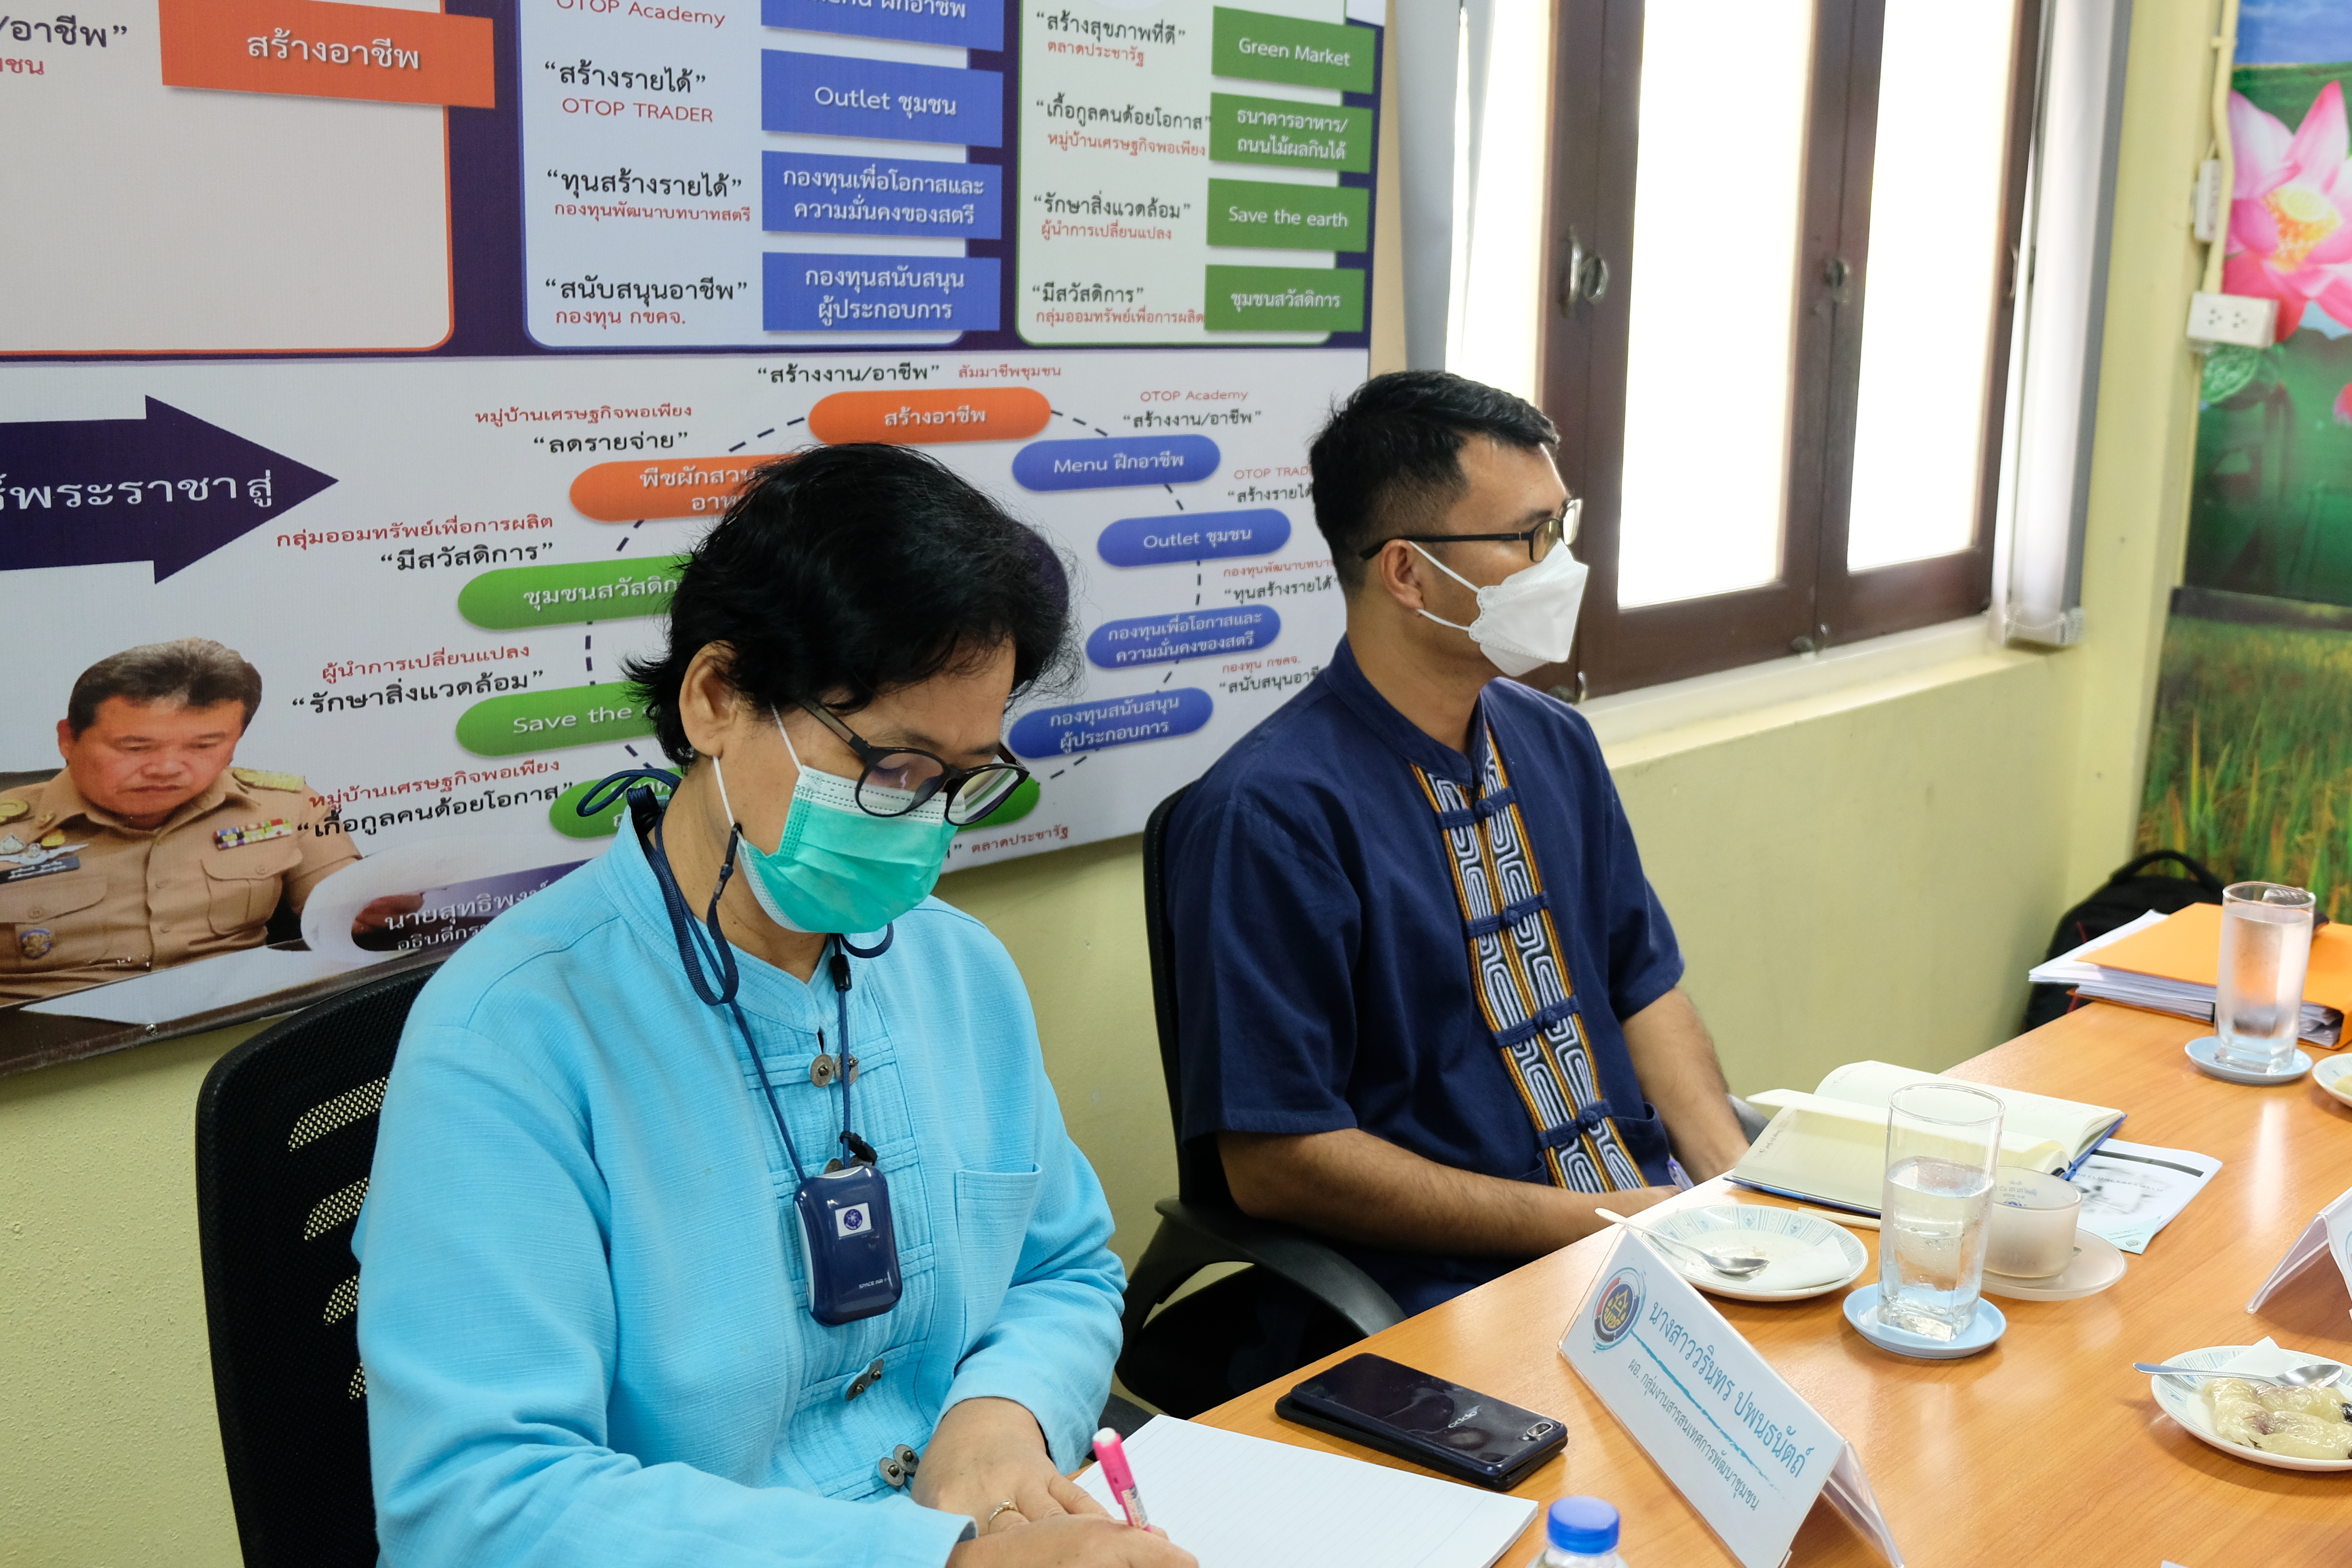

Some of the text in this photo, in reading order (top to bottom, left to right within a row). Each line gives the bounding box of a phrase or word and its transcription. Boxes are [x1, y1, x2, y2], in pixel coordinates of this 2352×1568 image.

[628, 1, 725, 28] Academy
[247, 27, 421, 70] สร้างอาชีพ
[1048, 40, 1145, 67] ตลาดประชารัฐ
[1239, 37, 1351, 67] Green Market
[0, 57, 44, 75] ชน
[562, 97, 713, 123] OTOP TRADER
[815, 86, 957, 119] Outlet ชุมชน
[1237, 109, 1349, 134] ธนาคารอาหาร/
[1048, 130, 1206, 156] หมู่บ้านเศรษฐกิจพอเพียง
[1237, 134, 1347, 160] ถนนไม้ผลกินได้
[783, 163, 985, 200] กองทุนเพื่อโอกาสและ
[555, 200, 751, 223] กองทุนพัฒนาบทบาทสตรี
[794, 195, 976, 225] ความมั่นคงของสตรี
[1229, 206, 1349, 229] Save the earth
[1041, 219, 1173, 241] ผู้นำการเปลี่ยนแปลง
[805, 266, 965, 292] กองทุนสนับสนุน
[818, 296, 953, 326] ผู้ประกอบการ
[1231, 288, 1341, 313] ชุมชนสวัสดิการ
[555, 308, 686, 329] กองทุน กขคจ.
[1036, 305, 1205, 327] กลุ่มออมทรัพย์เพื่อการผลิต
[958, 364, 1062, 381] สัมมาชีพชุมชน
[1140, 390, 1248, 402] OTOP Academy
[475, 403, 692, 427] หมู่บ้านเศรษฐกิจพอเพียง
[884, 405, 986, 427] สร้างอาชีพ
[1054, 451, 1184, 474] Menu ฝึกอาชีพ
[1234, 465, 1312, 479] OTOP TRAD
[248, 470, 272, 508] สู่
[1228, 482, 1312, 502] “สร้างรายได้
[277, 513, 553, 550] กลุ่มออมทรัพย์เพื่อการผลิต
[1144, 528, 1251, 549] Outlet ชุมชน
[524, 575, 677, 611] ชุมชนสวัสดิก
[1108, 611, 1262, 641] กองทุนเพื่อโอกาสและ
[1117, 631, 1255, 663] ความมั่นคงของสตรี
[322, 645, 530, 685] ผู้นำการเปลี่ยนแปลง
[1223, 654, 1301, 674] กองทุน กขคจ.
[514, 715, 577, 734] Save
[588, 707, 632, 723] the
[1050, 695, 1180, 727] กองทุนสนับสนุน
[1060, 720, 1169, 753] ผู้ประกอบการ
[309, 759, 560, 810] หมู่บ้านเศรษฐกิจพอเพียง
[971, 824, 1068, 853] ตลาดประชารัฐ
[1649, 1300, 1815, 1478] นางสาววรินทร ปพนธนัตถ์
[1628, 1358, 1760, 1511] ผอ. กลุ่มงานสารสนเทศการพัฒนาชุมชน
